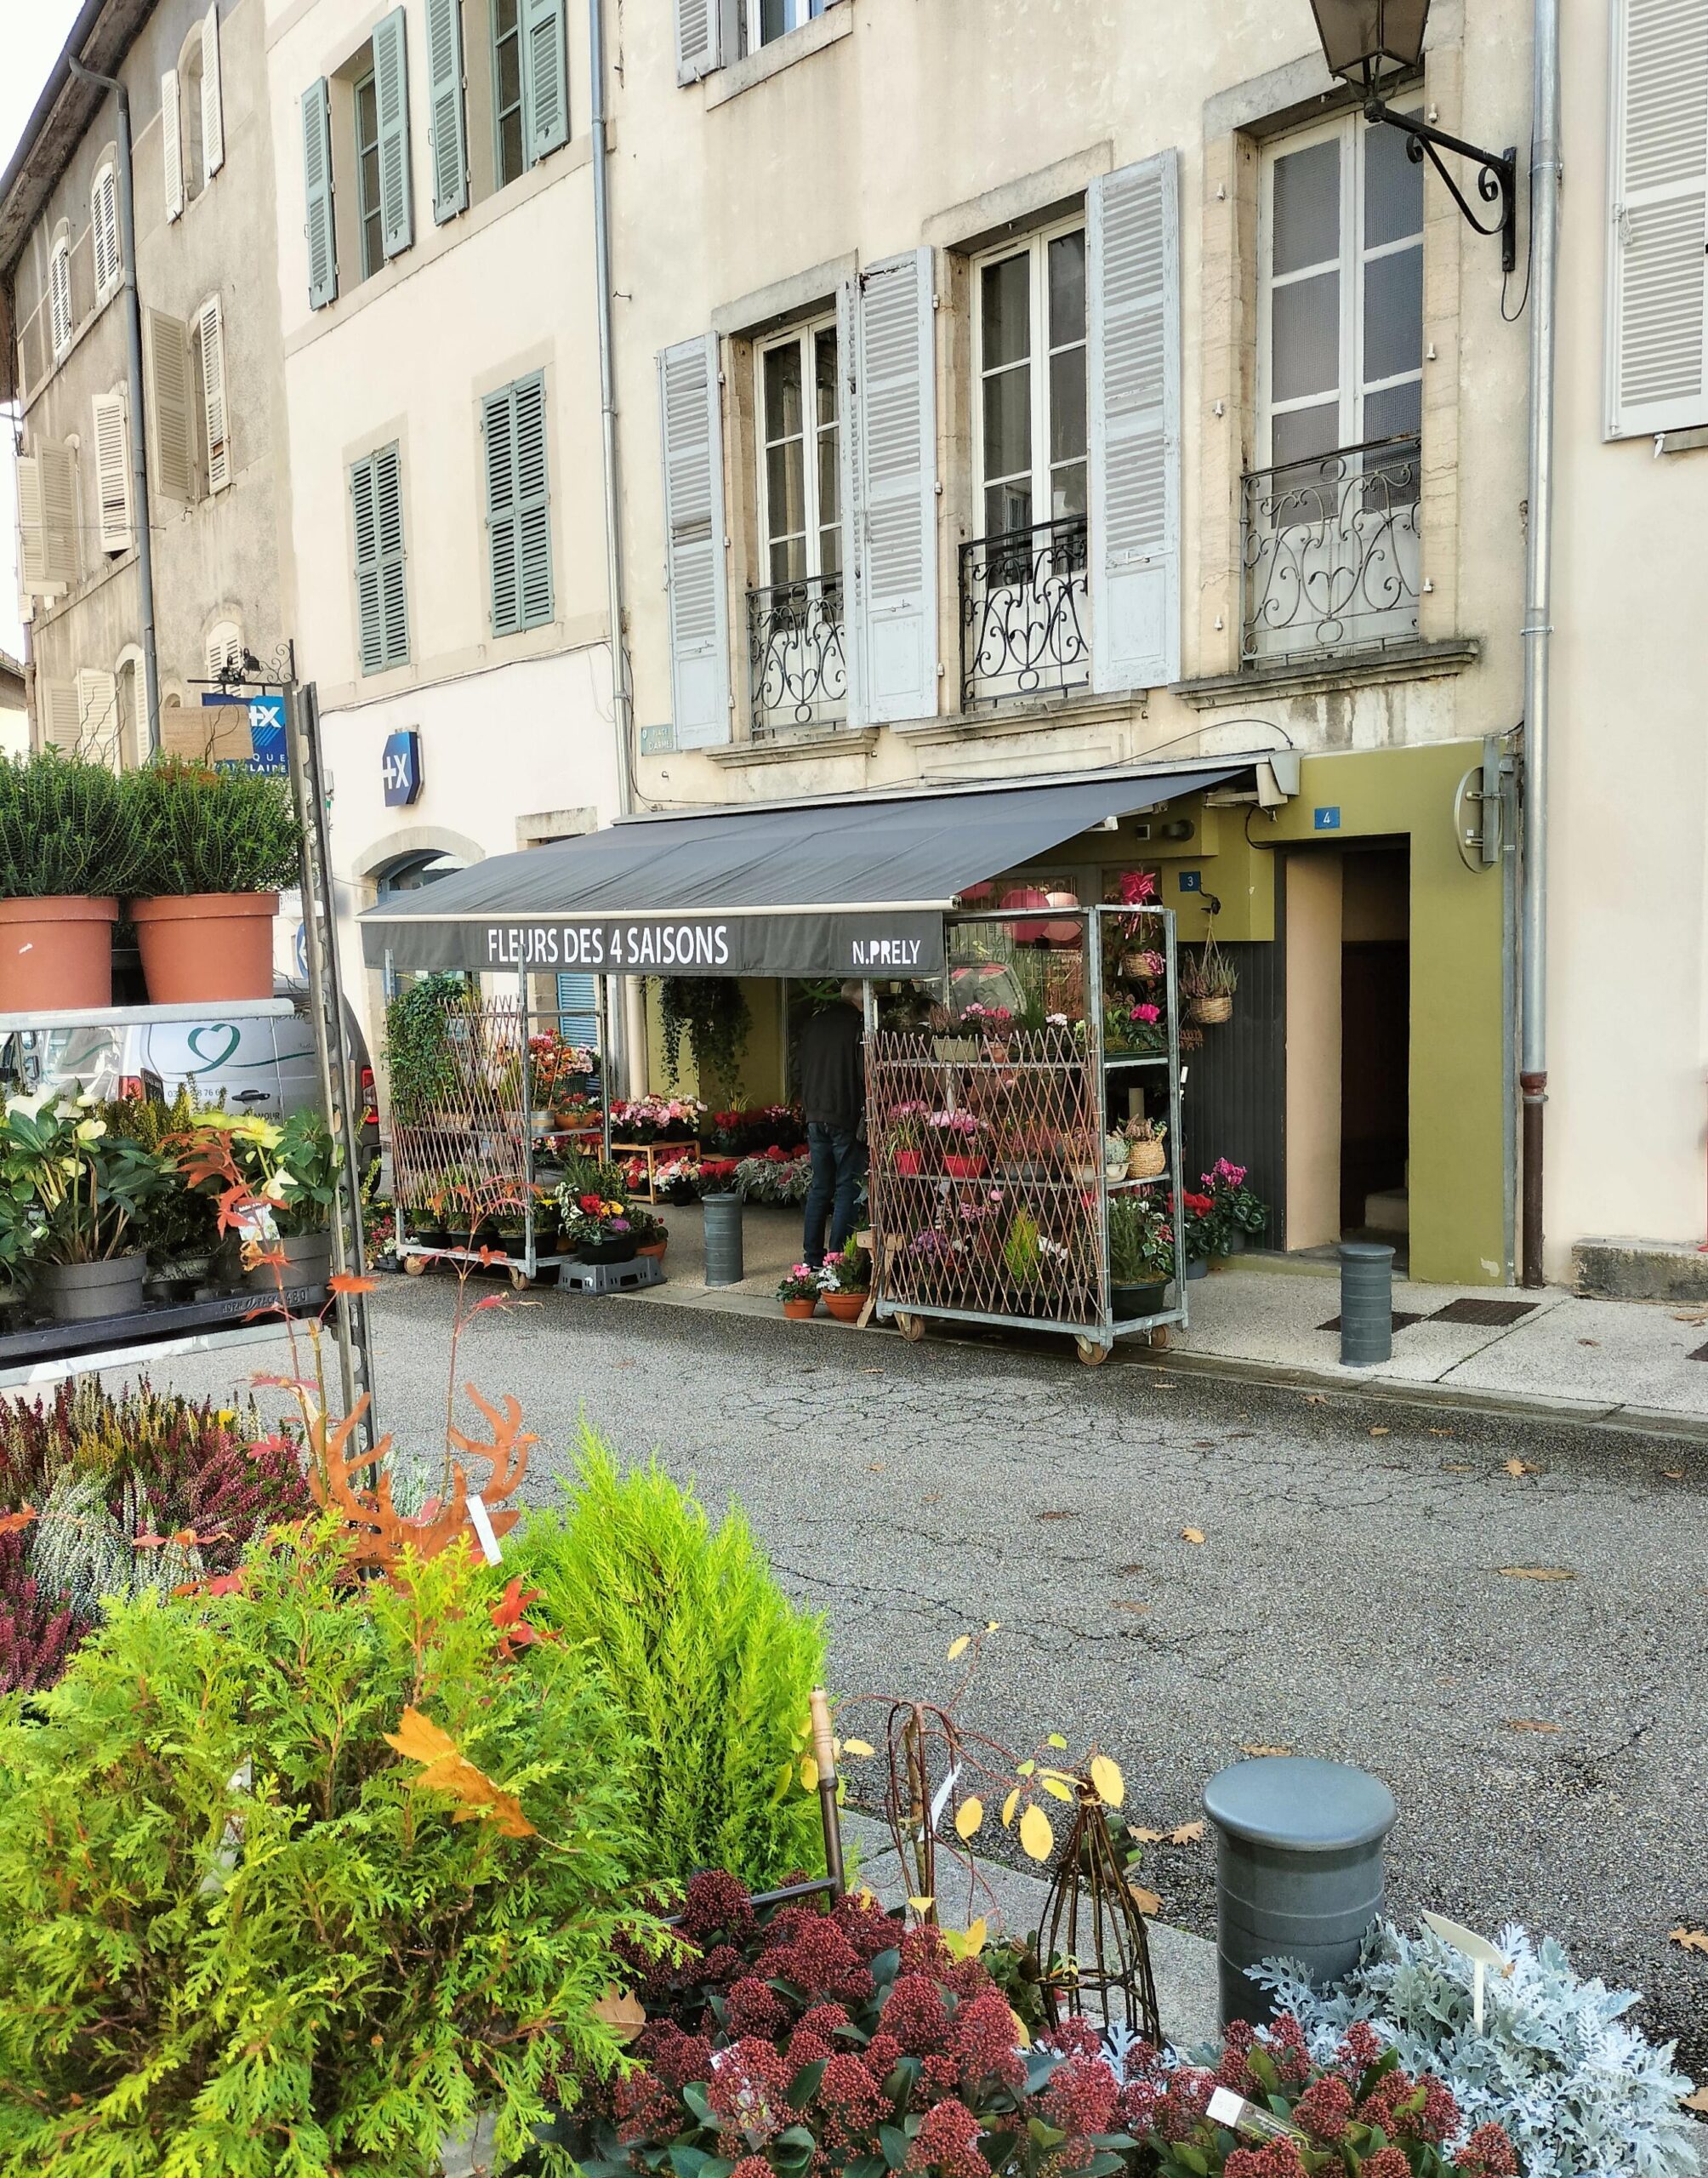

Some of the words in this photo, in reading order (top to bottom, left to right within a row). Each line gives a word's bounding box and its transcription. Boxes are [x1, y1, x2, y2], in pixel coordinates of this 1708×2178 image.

[253, 753, 286, 762] QUE
[1323, 812, 1330, 824] 4
[1187, 876, 1193, 887] 3
[487, 927, 559, 963] FLEURS
[564, 927, 604, 963] DES
[610, 927, 623, 964] 4
[627, 925, 729, 965] SAISONS
[852, 939, 921, 965] N.PRELY
[204, 1088, 214, 1097] 76
